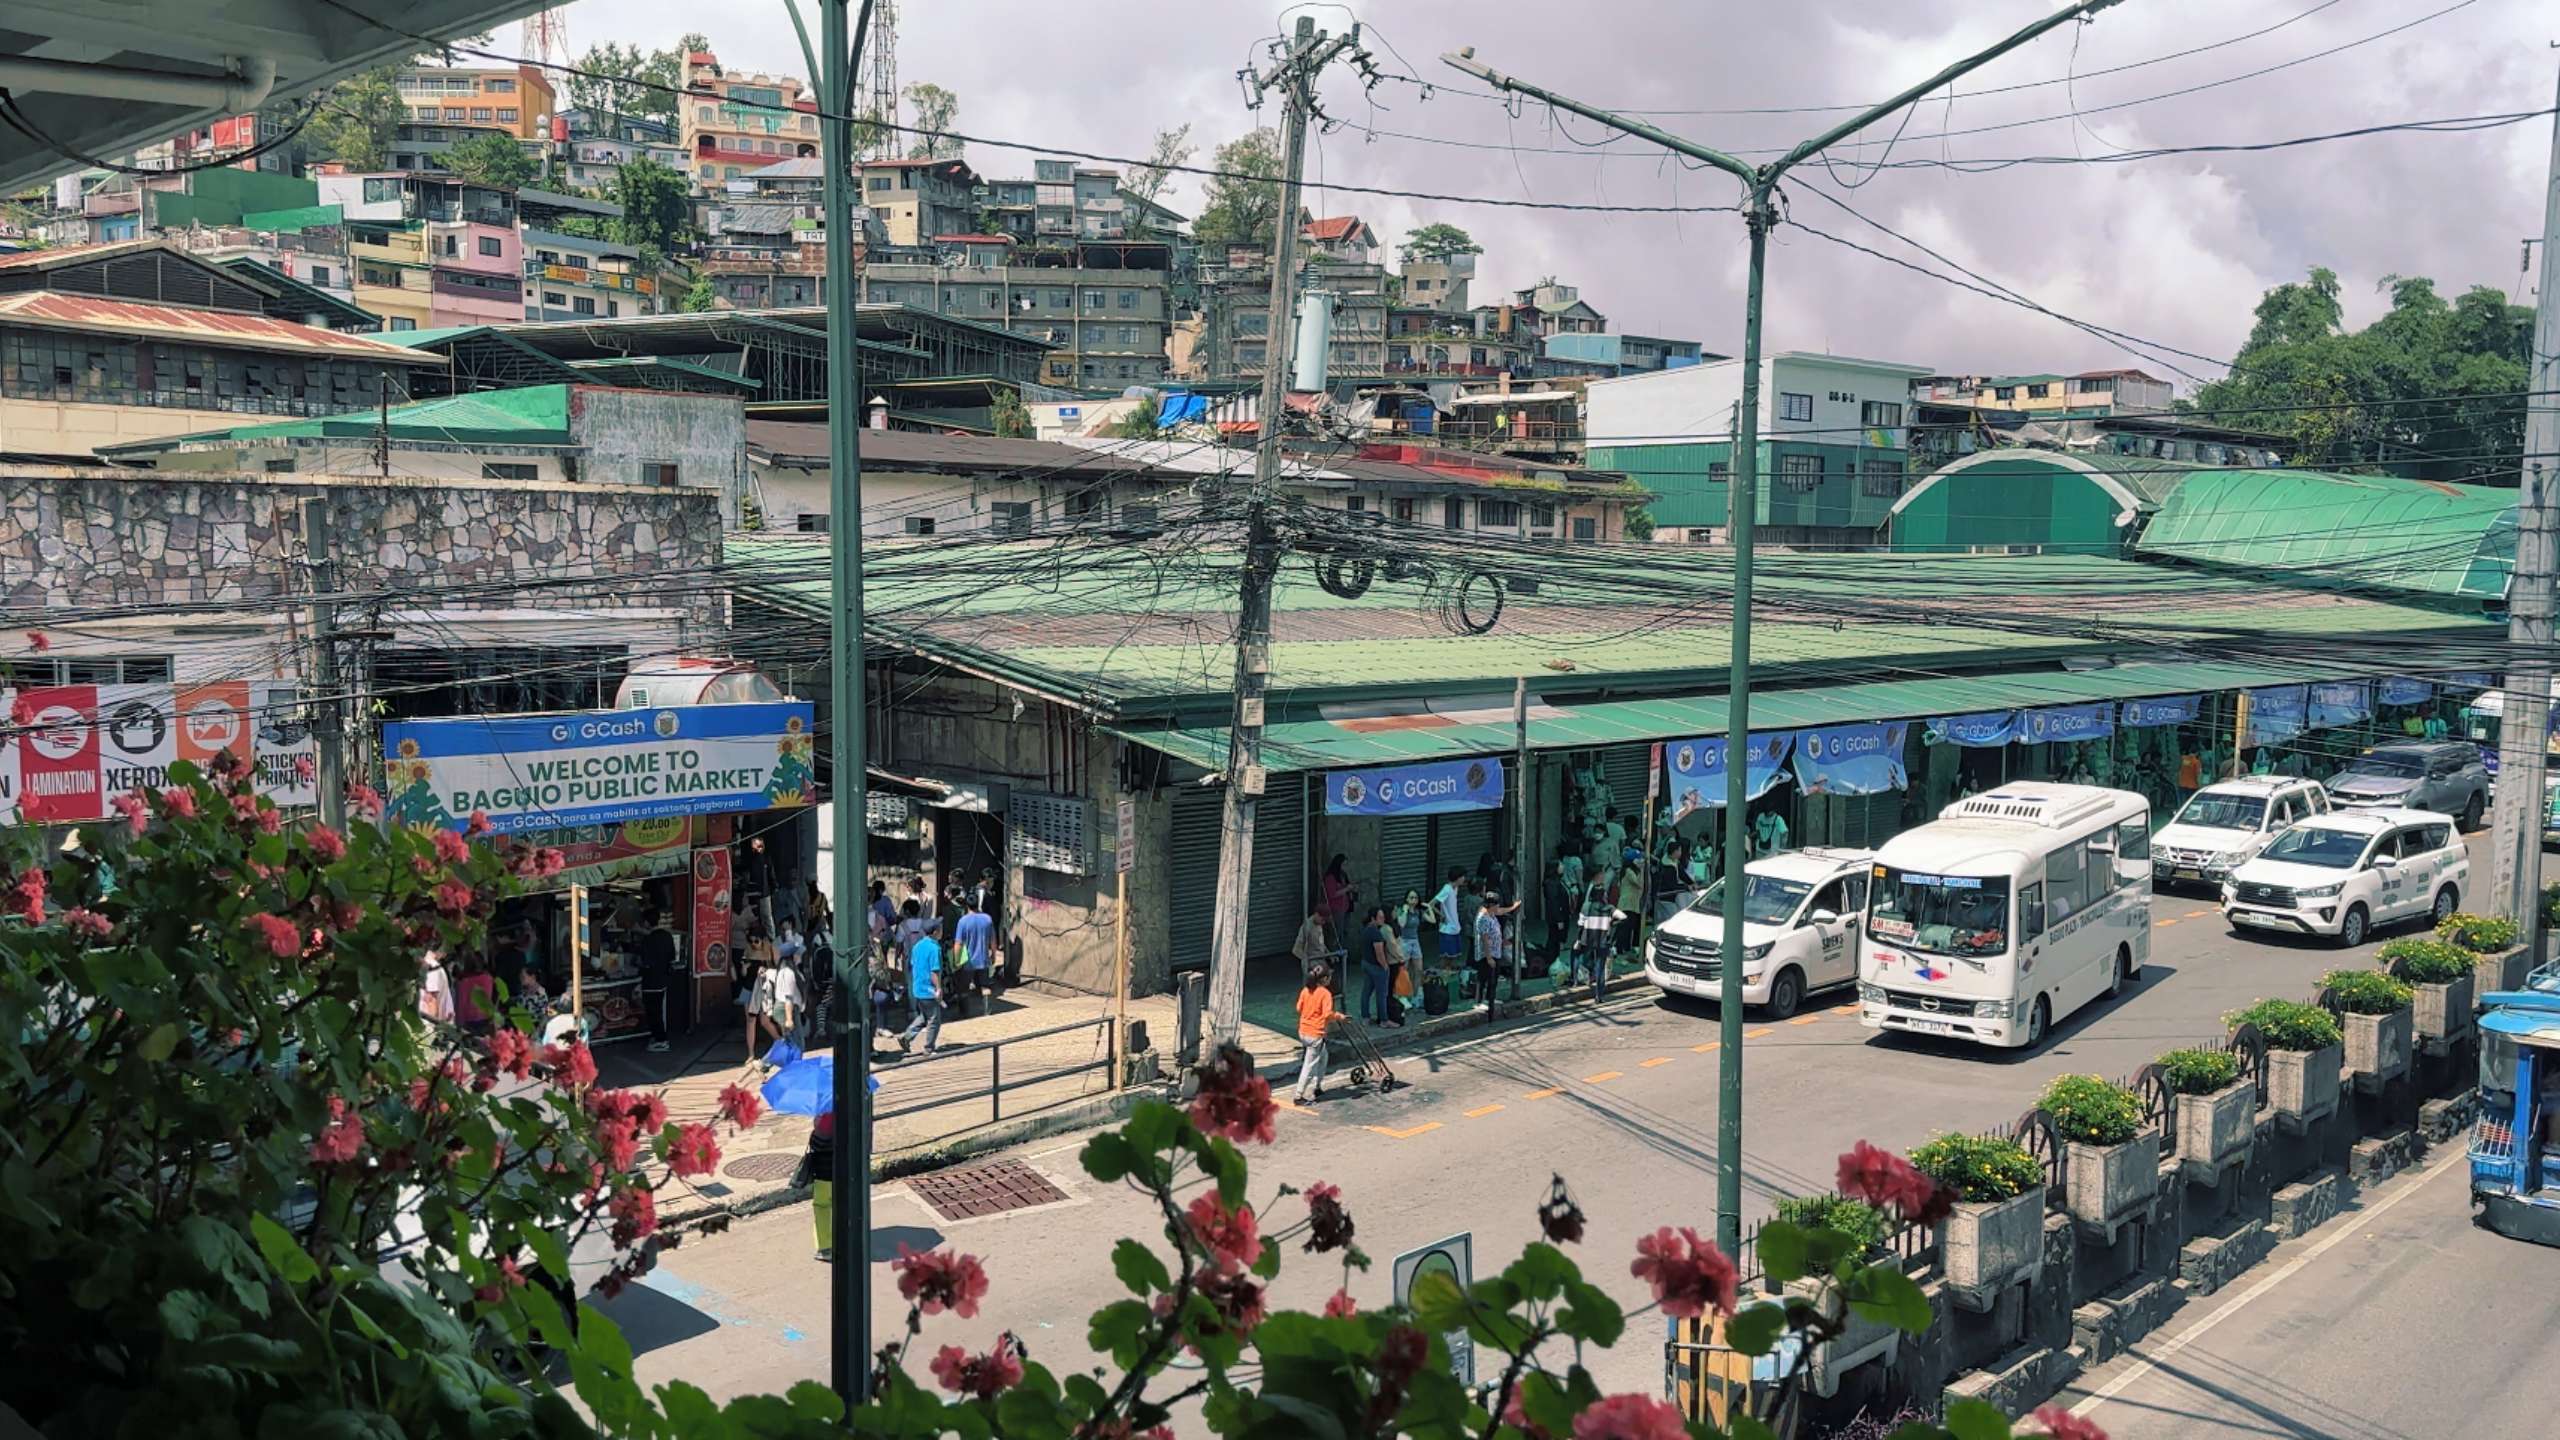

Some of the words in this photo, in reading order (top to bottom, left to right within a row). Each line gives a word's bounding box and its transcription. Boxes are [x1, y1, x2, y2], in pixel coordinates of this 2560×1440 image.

[581, 717, 646, 739] GCash
[1845, 736, 1880, 753] GCash
[527, 752, 661, 784] WELCOME
[665, 750, 700, 771] TO
[25, 769, 96, 796] LAMINATION
[453, 784, 562, 813] BAGUIO
[568, 775, 658, 803] PUBLIC
[665, 768, 764, 795] MARKET
[1403, 775, 1457, 798] GCash
[563, 813, 588, 826] para
[589, 812, 601, 821] sa
[603, 808, 639, 819] mabilis
[641, 805, 652, 815] at
